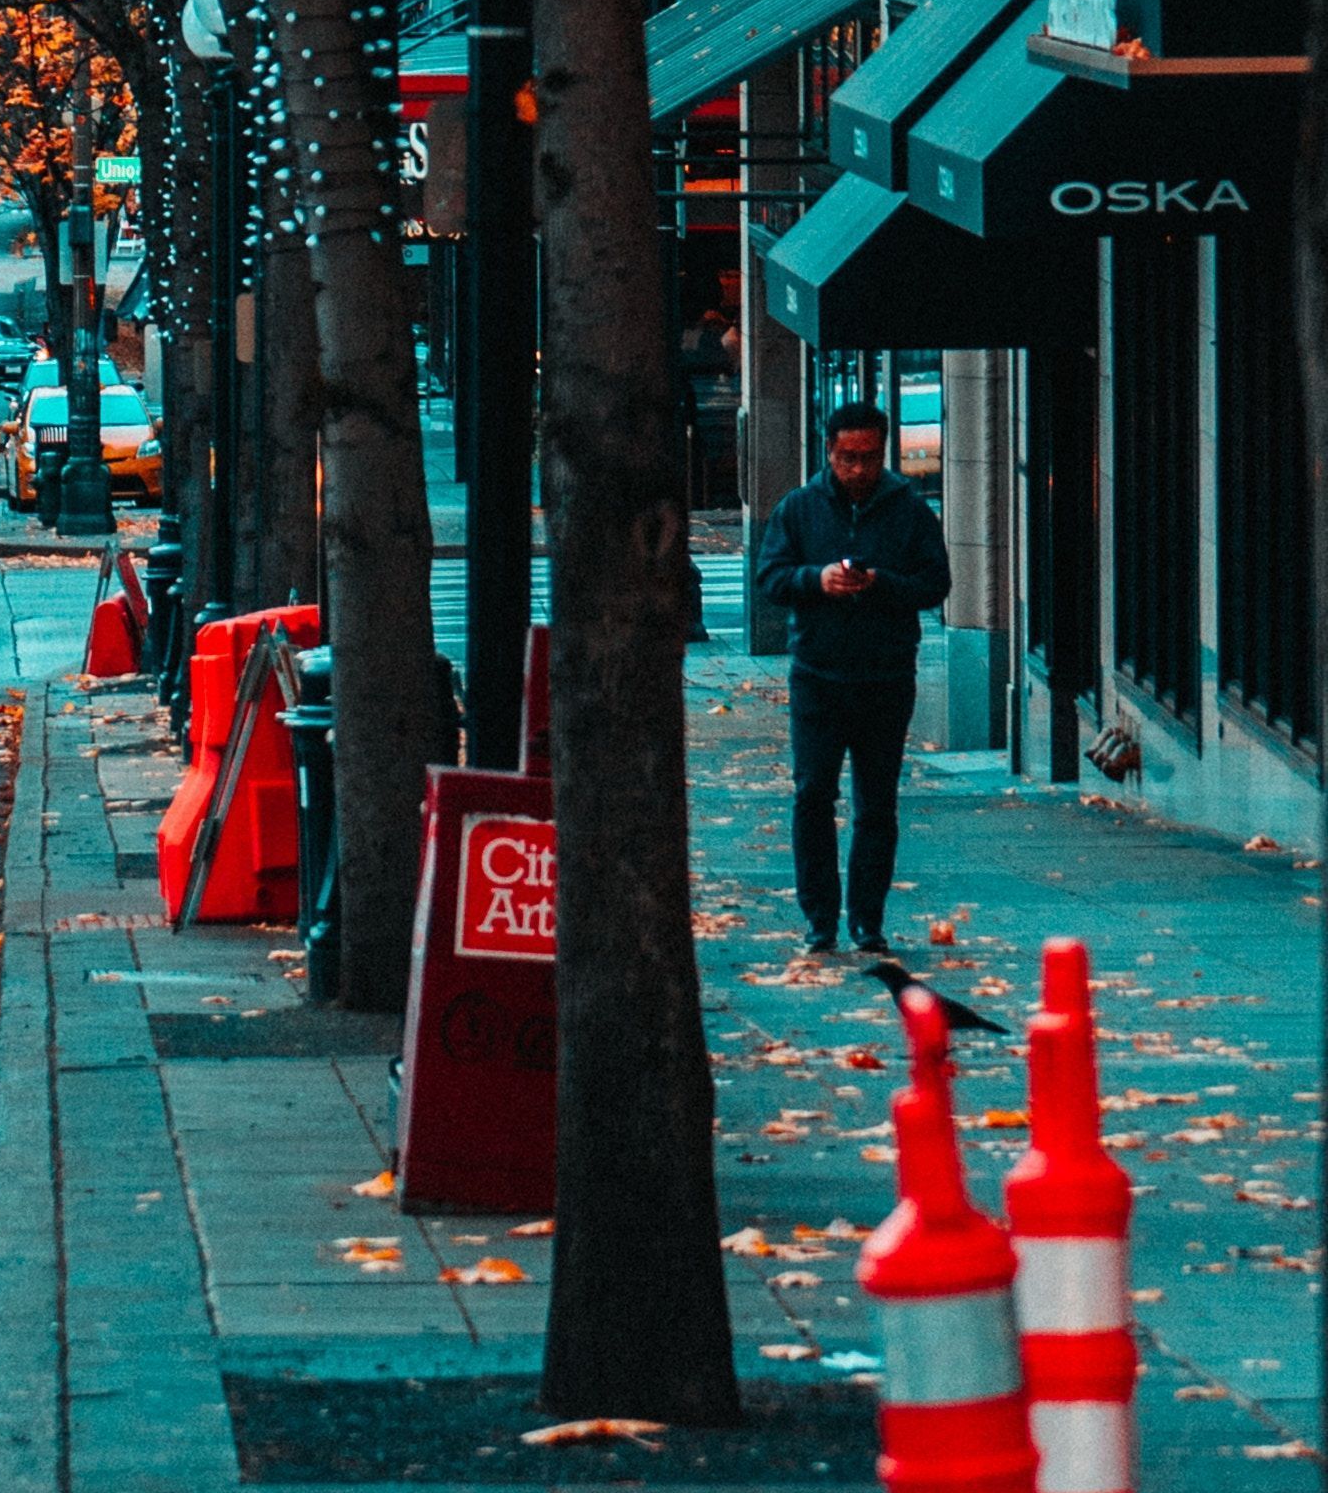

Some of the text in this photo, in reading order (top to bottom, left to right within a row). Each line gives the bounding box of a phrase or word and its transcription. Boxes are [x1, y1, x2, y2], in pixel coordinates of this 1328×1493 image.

[1050, 179, 1250, 215] OSKA
[481, 837, 556, 887] Cit
[476, 887, 555, 937] Art
